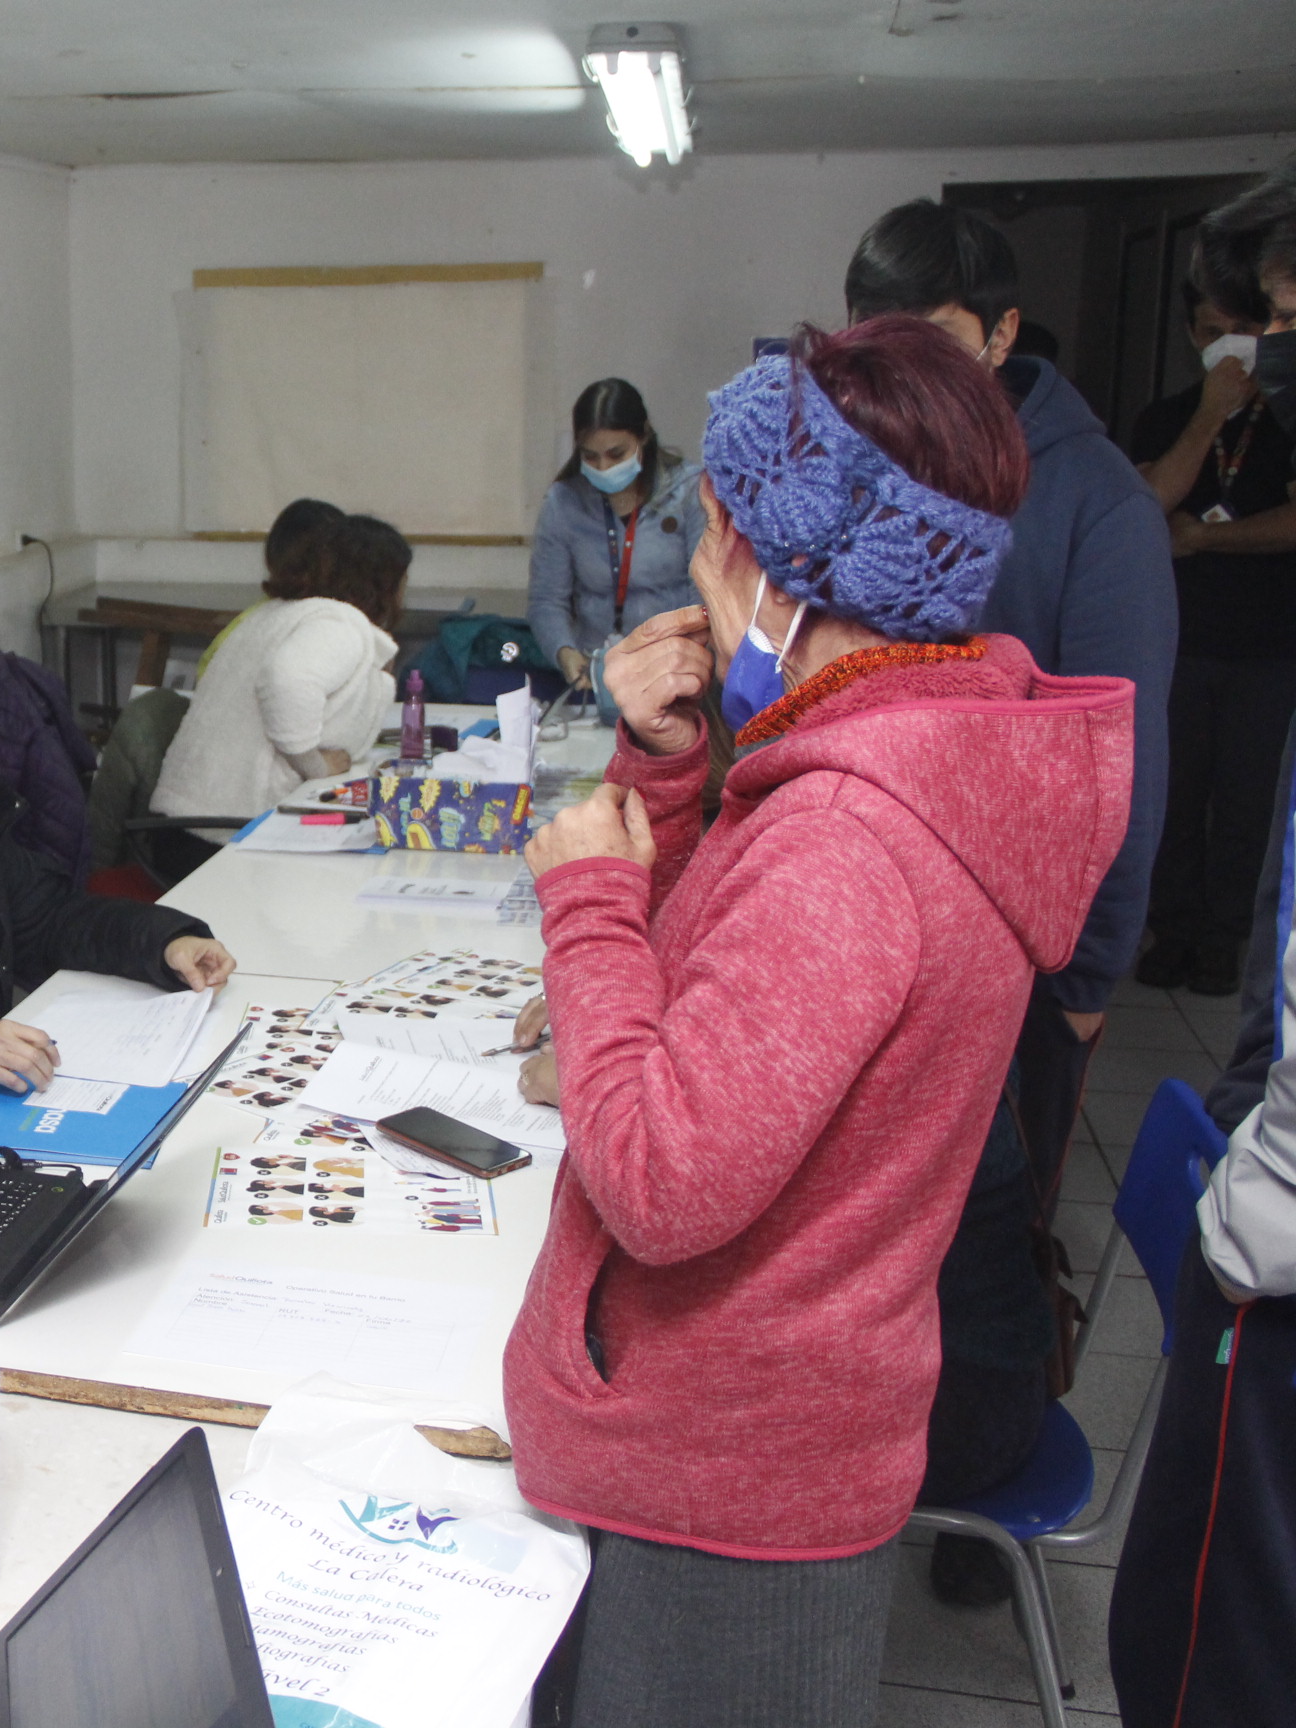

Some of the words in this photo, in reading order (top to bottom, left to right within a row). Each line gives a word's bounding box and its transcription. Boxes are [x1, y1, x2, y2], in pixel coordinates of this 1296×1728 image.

[229, 1490, 303, 1528] Centro
[309, 1528, 386, 1562] médico
[386, 1551, 409, 1566] y
[417, 1560, 551, 1602] radiológico
[307, 1559, 342, 1576] La
[349, 1566, 425, 1592] Calera
[264, 1590, 355, 1620] Consultas
[276, 1571, 308, 1592] Más
[312, 1584, 355, 1602] salud
[354, 1593, 392, 1609] para
[395, 1601, 442, 1621] todos
[262, 1669, 321, 1692] ivel
[313, 1686, 331, 1697] 2
